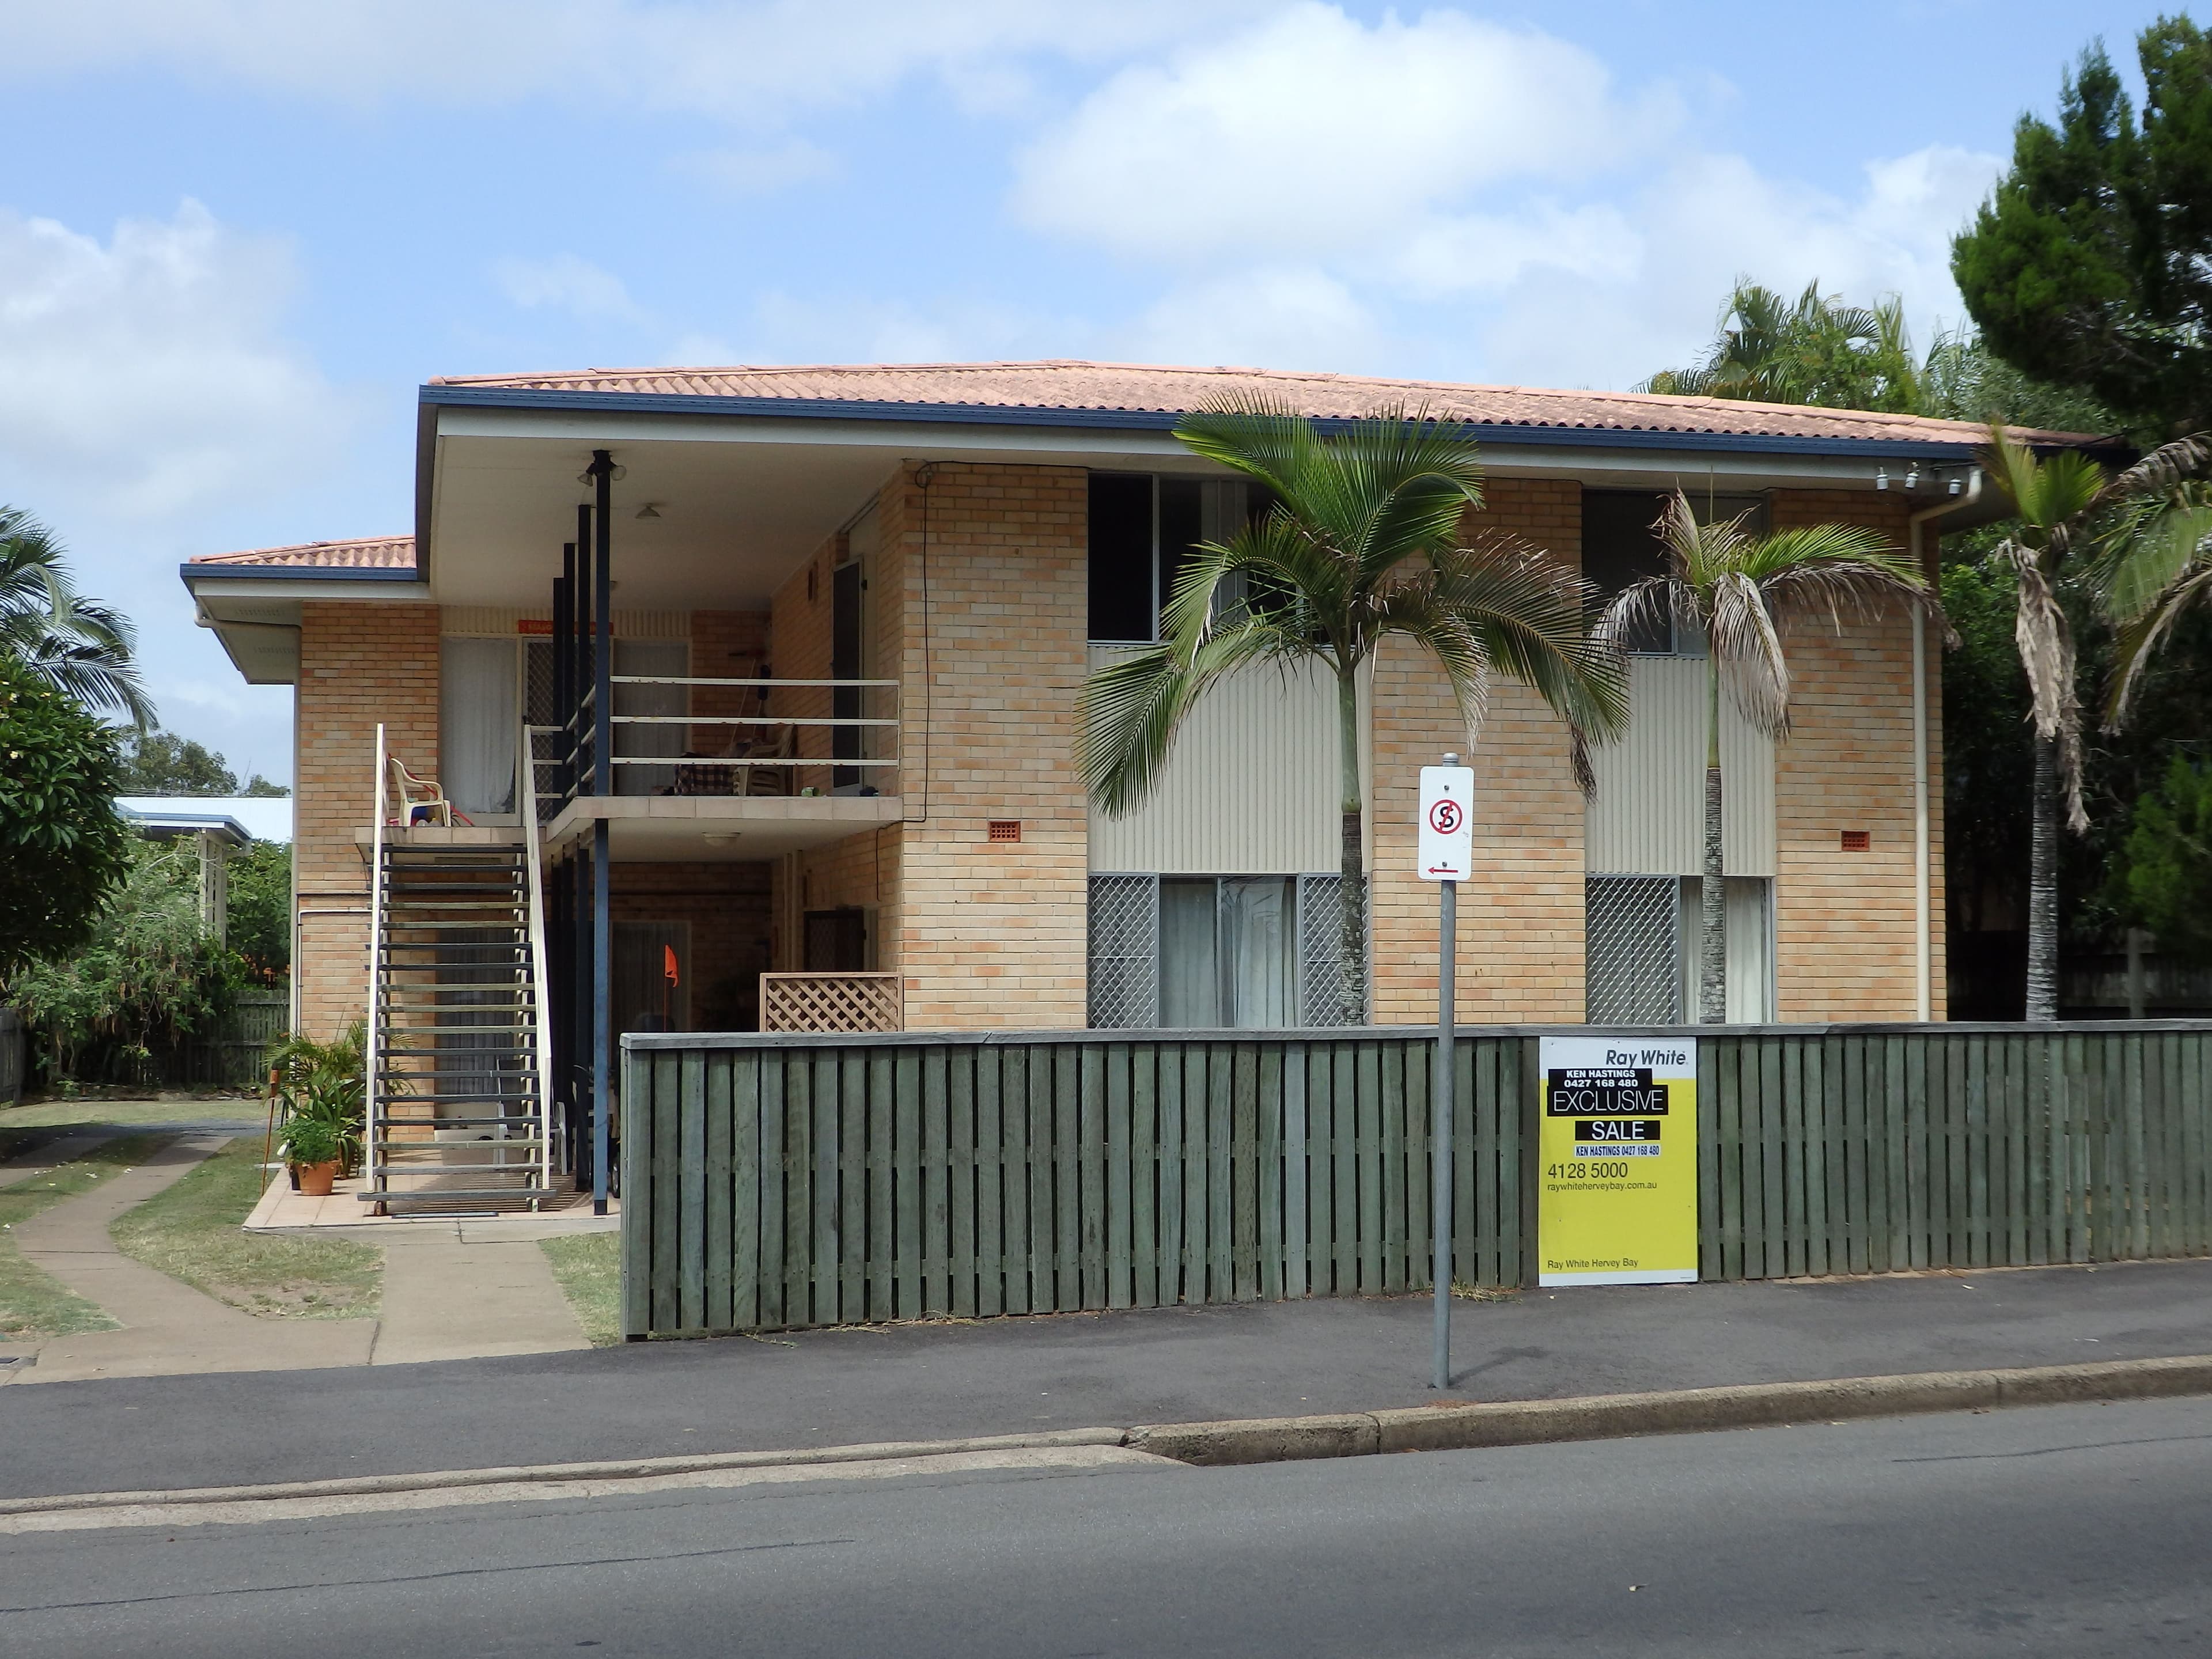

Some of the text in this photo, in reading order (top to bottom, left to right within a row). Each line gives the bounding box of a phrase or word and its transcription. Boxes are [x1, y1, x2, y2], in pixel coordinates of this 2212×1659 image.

[1606, 1050, 1687, 1067] Ray White
[1567, 1070, 1635, 1078] KEN HASTINGS
[1595, 1080, 1615, 1088] 168
[1554, 1090, 1664, 1111] EXCLUSIVE
[1592, 1121, 1645, 1140] SALE
[1576, 1146, 1588, 1156] KEN
[1590, 1146, 1620, 1156] HASTINGS
[1622, 1146, 1635, 1156] 0427
[1649, 1146, 1659, 1155] 480
[1548, 1162, 1628, 1179] 4128 5000
[1547, 1181, 1657, 1192] raywhiteherveybay.com.au
[1547, 1258, 1638, 1270] Ray White Hervey Bay
